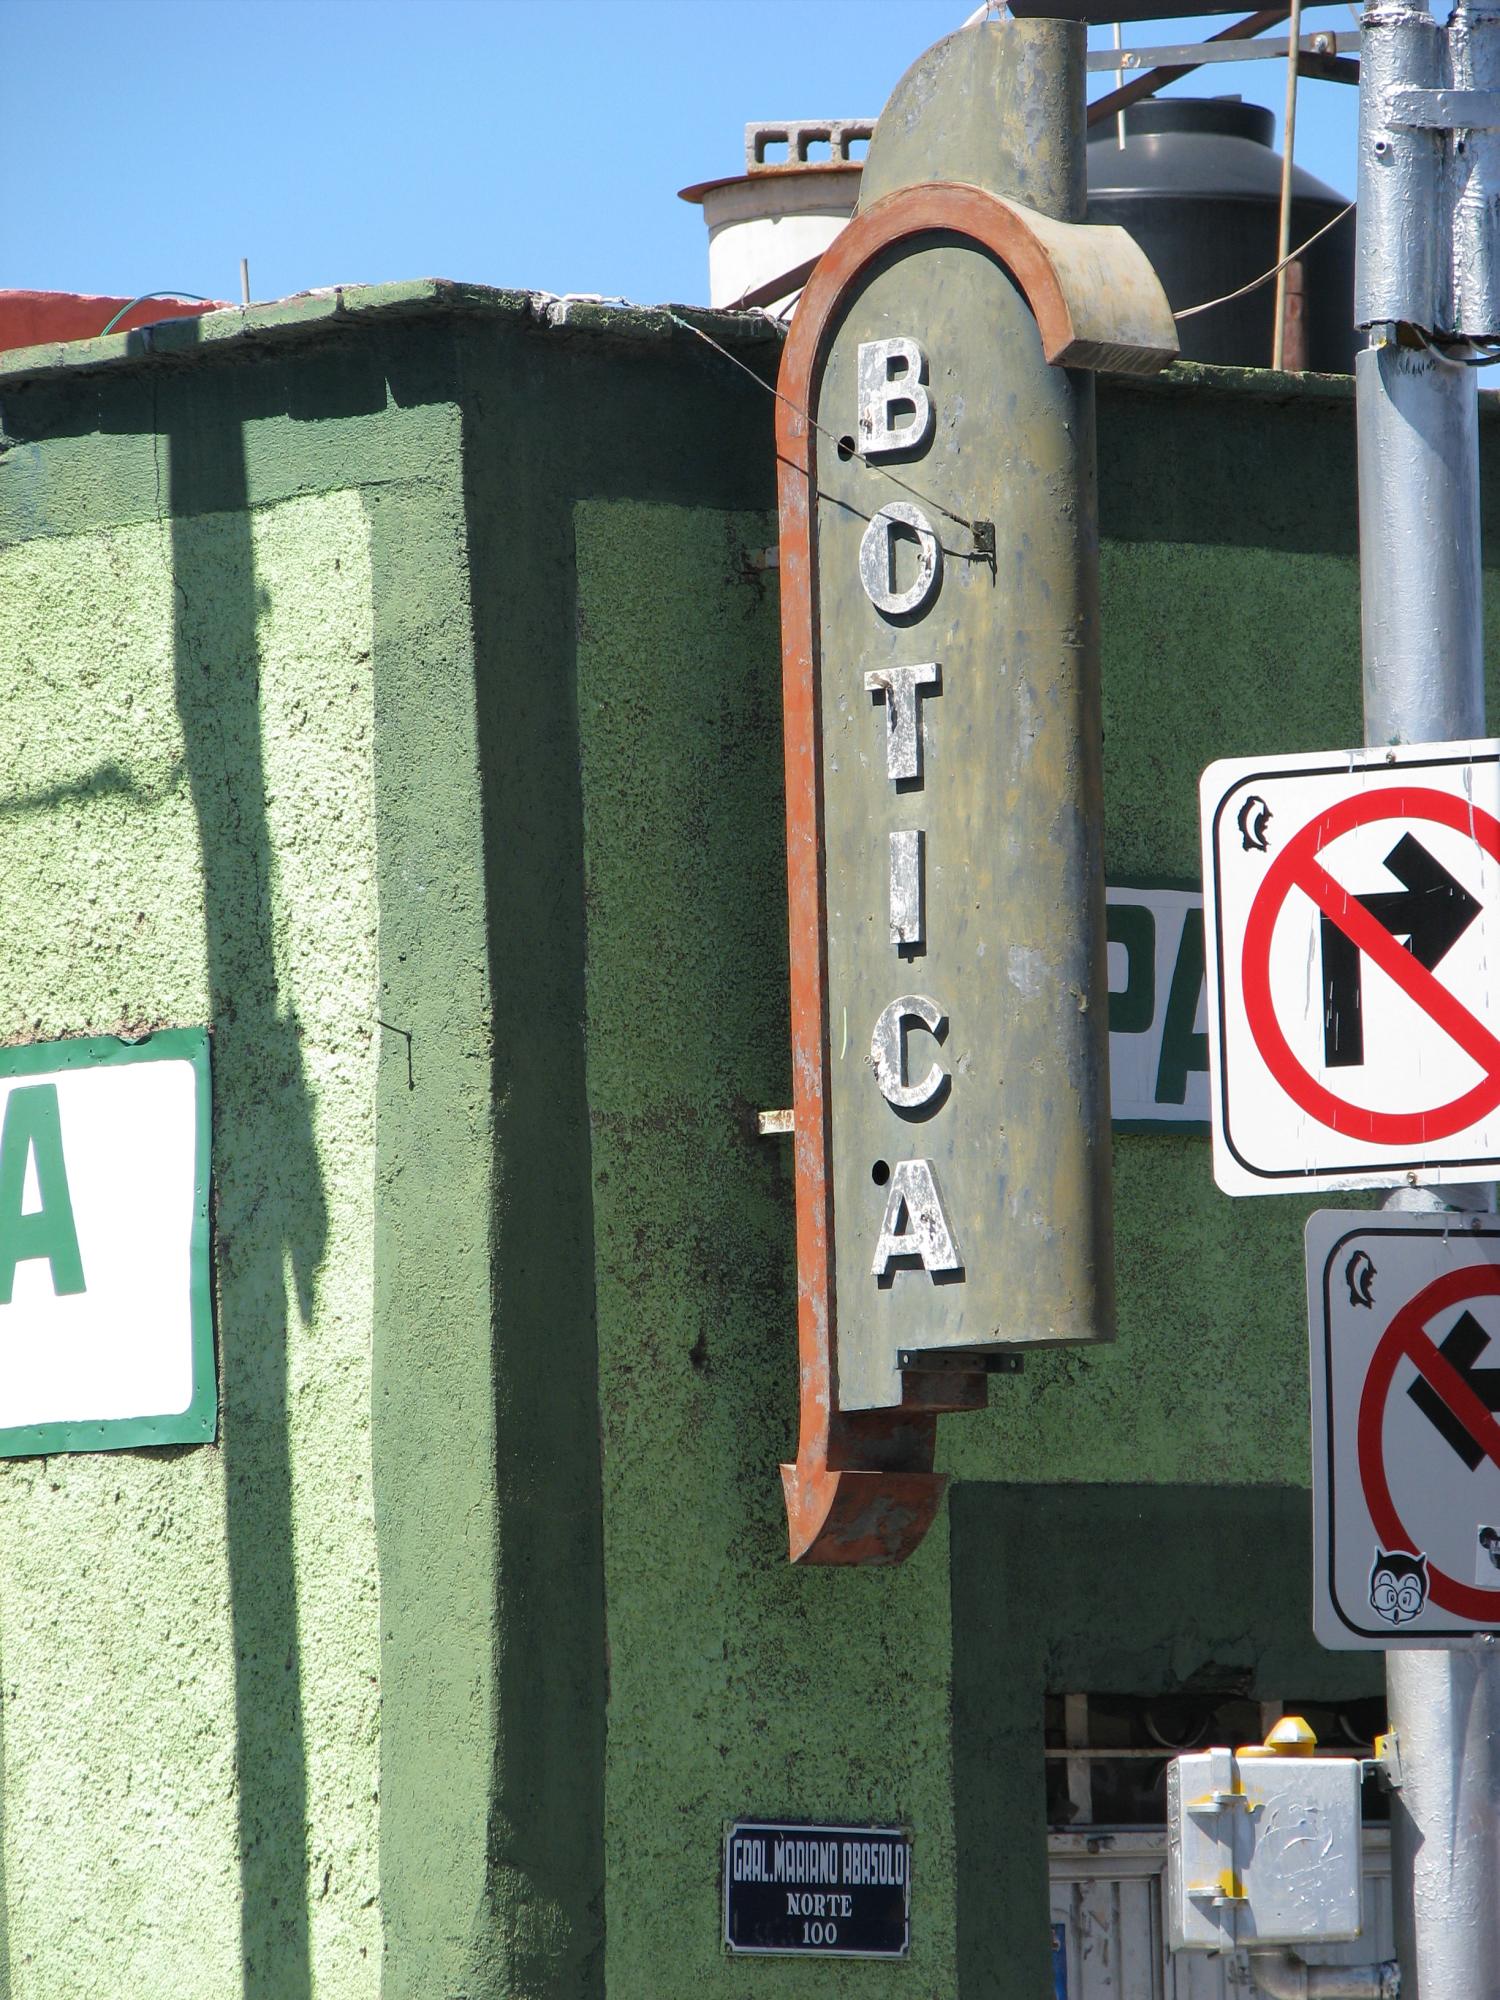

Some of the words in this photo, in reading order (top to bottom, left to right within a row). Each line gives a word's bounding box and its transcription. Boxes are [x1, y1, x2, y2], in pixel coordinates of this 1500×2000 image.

[857, 336, 962, 1276] BOTICA
[733, 1839, 773, 1882] GRAL.
[774, 1839, 838, 1884] MARIANO
[842, 1842, 904, 1885] ABASOLO
[786, 1892, 852, 1917] NORTE
[802, 1922, 837, 1945] 100
